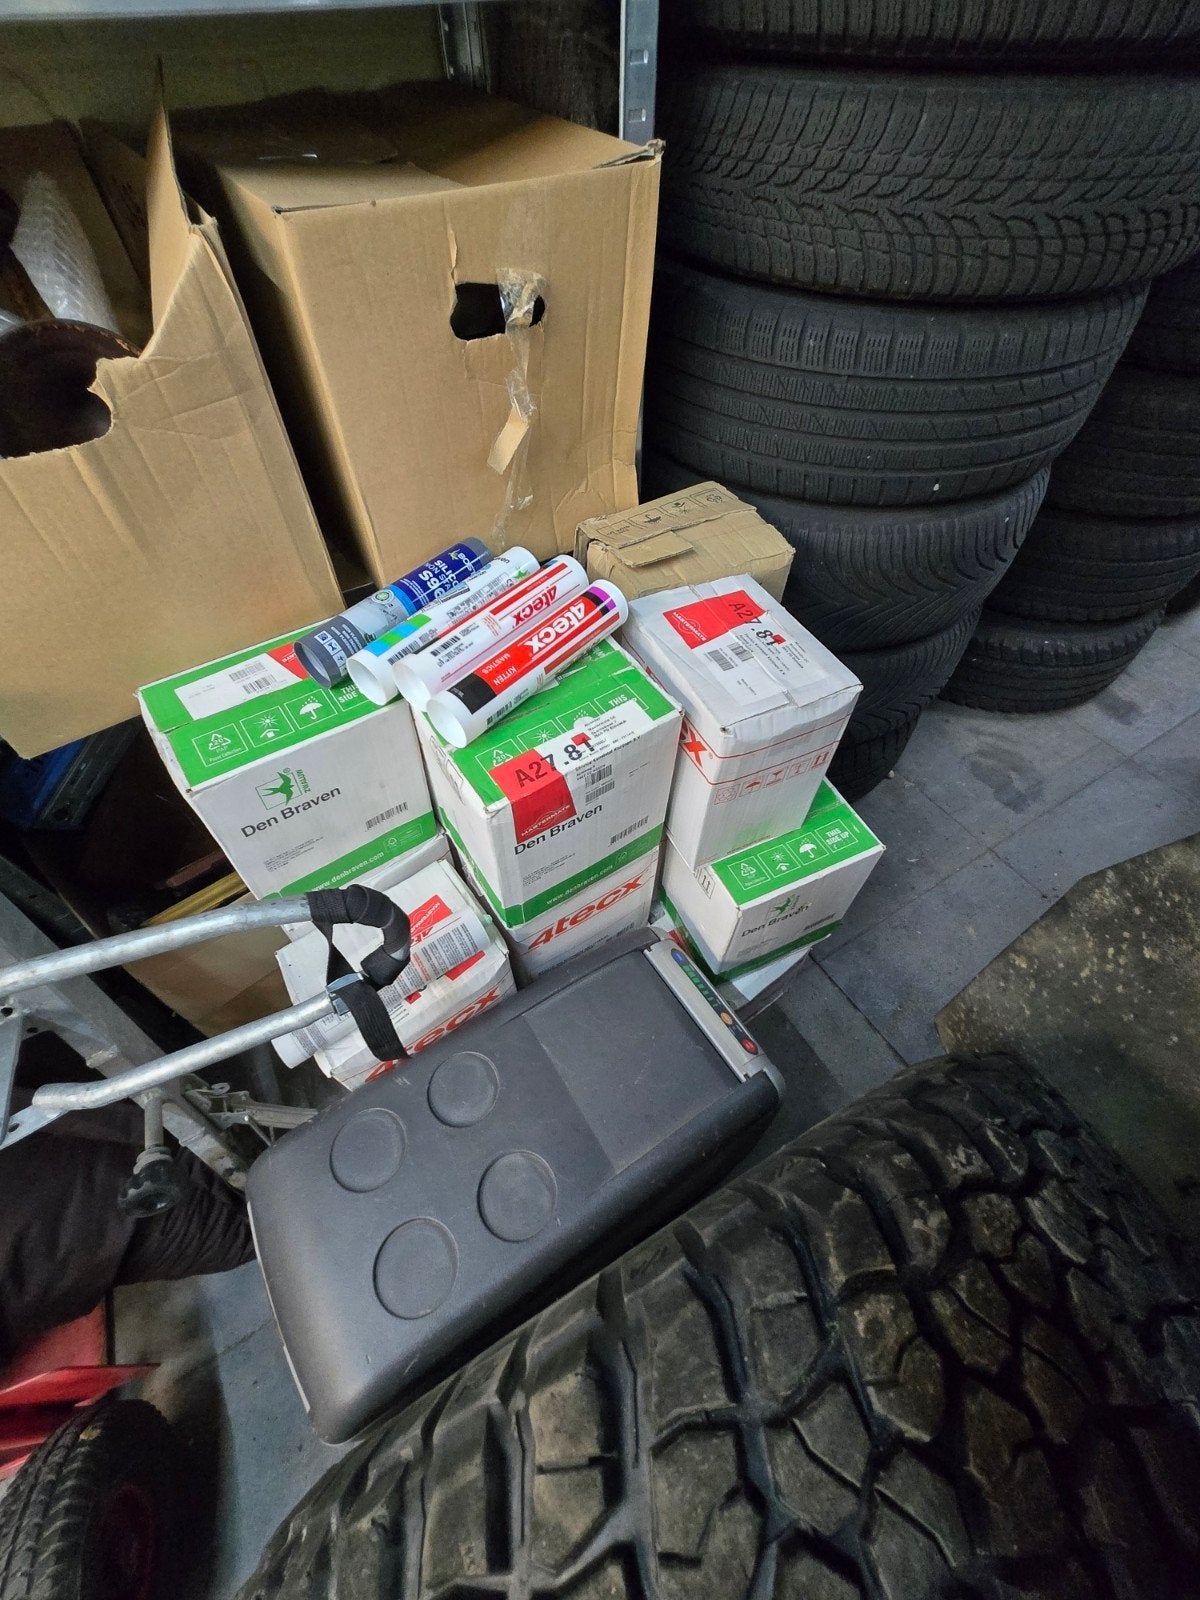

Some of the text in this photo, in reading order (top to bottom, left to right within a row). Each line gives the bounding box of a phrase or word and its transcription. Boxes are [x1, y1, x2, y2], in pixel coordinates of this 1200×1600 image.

[434, 560, 459, 587] SILICO
[458, 552, 477, 575] BOST
[512, 585, 557, 627] 4tecx
[524, 601, 586, 654] 4tecx
[481, 652, 511, 675] MASTICS
[493, 666, 518, 686] KITTEN
[338, 691, 358, 703] SIDE
[341, 684, 359, 695] THI
[608, 694, 628, 708] THIS
[515, 738, 597, 788] A27.81
[240, 786, 342, 838] Den Braven
[521, 804, 571, 837] MASTERMATE
[514, 804, 603, 856] Den Braven
[826, 828, 842, 838] THIS
[546, 865, 613, 905] www.denbraven.com
[410, 902, 440, 933] MASTERMA
[528, 874, 643, 950] 4tecx
[741, 905, 809, 937] Den Braven
[364, 986, 499, 1083] 4ecx
